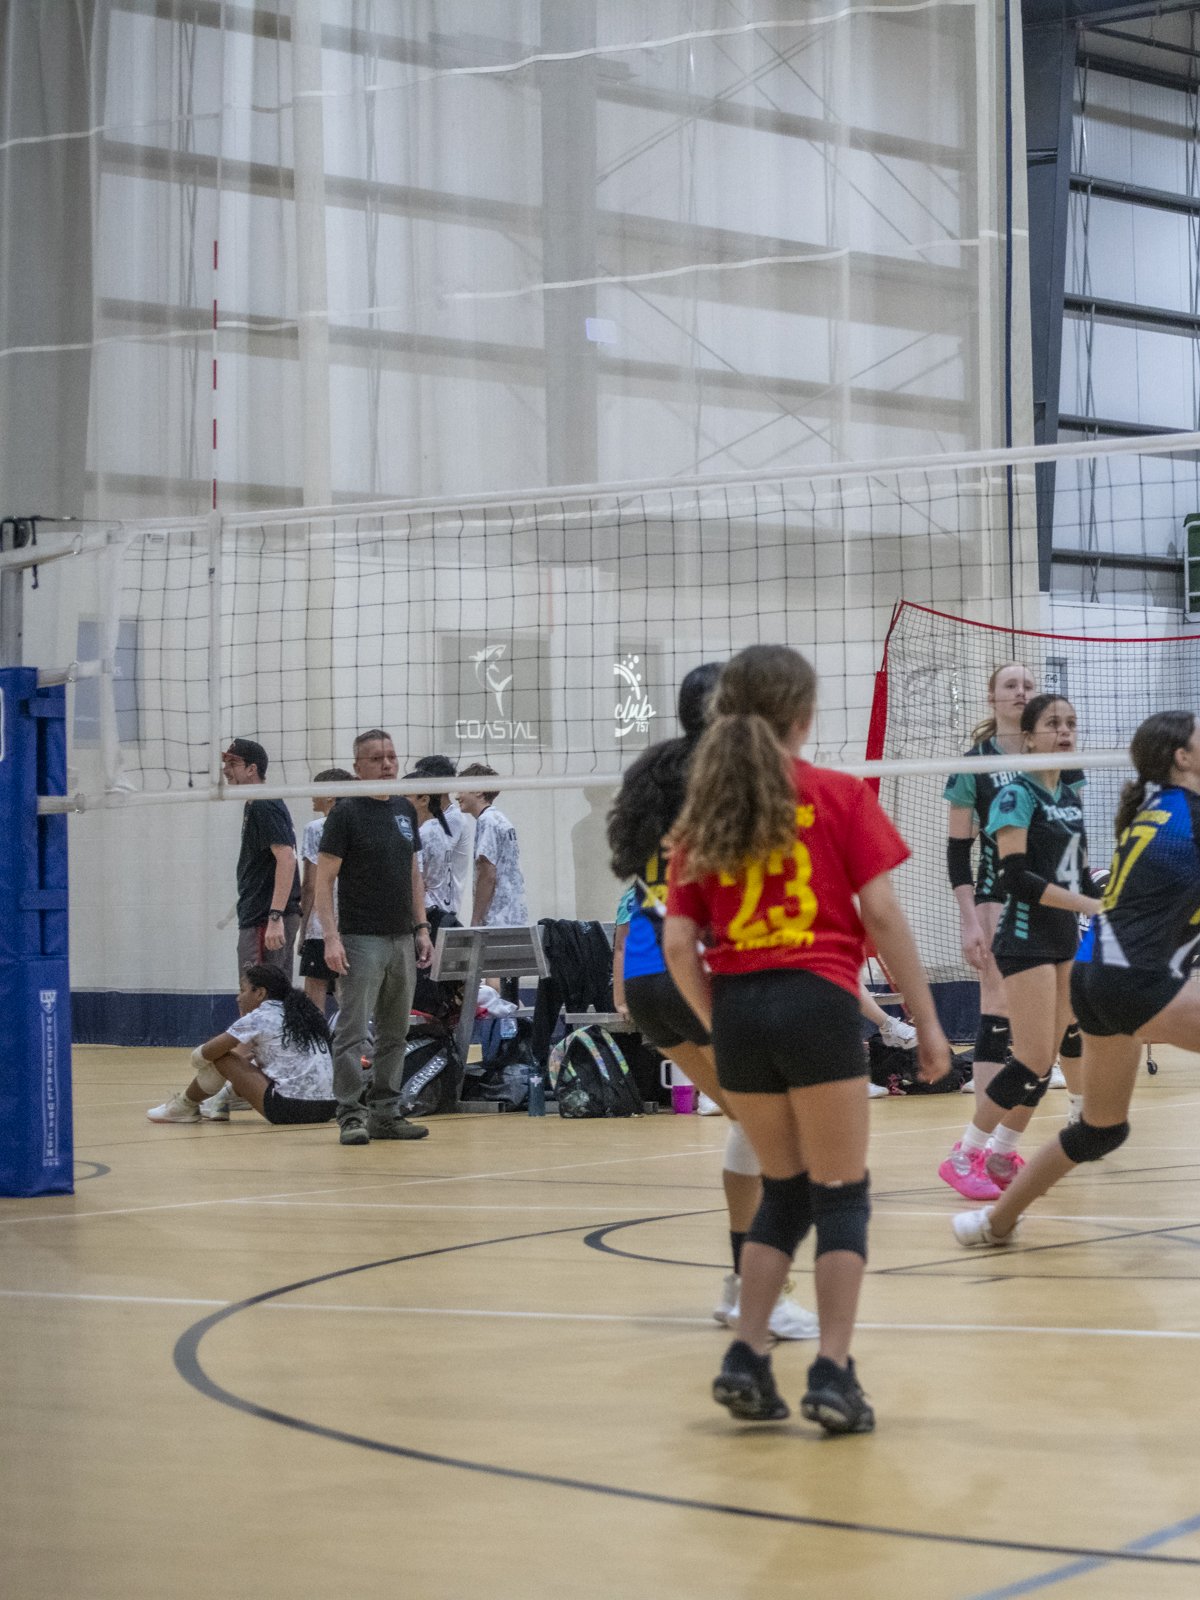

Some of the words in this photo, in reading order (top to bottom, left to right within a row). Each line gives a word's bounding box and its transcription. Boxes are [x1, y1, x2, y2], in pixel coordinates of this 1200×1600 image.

[455, 720, 538, 739] COASTAL
[718, 840, 818, 940] 23
[1056, 832, 1081, 895] 4
